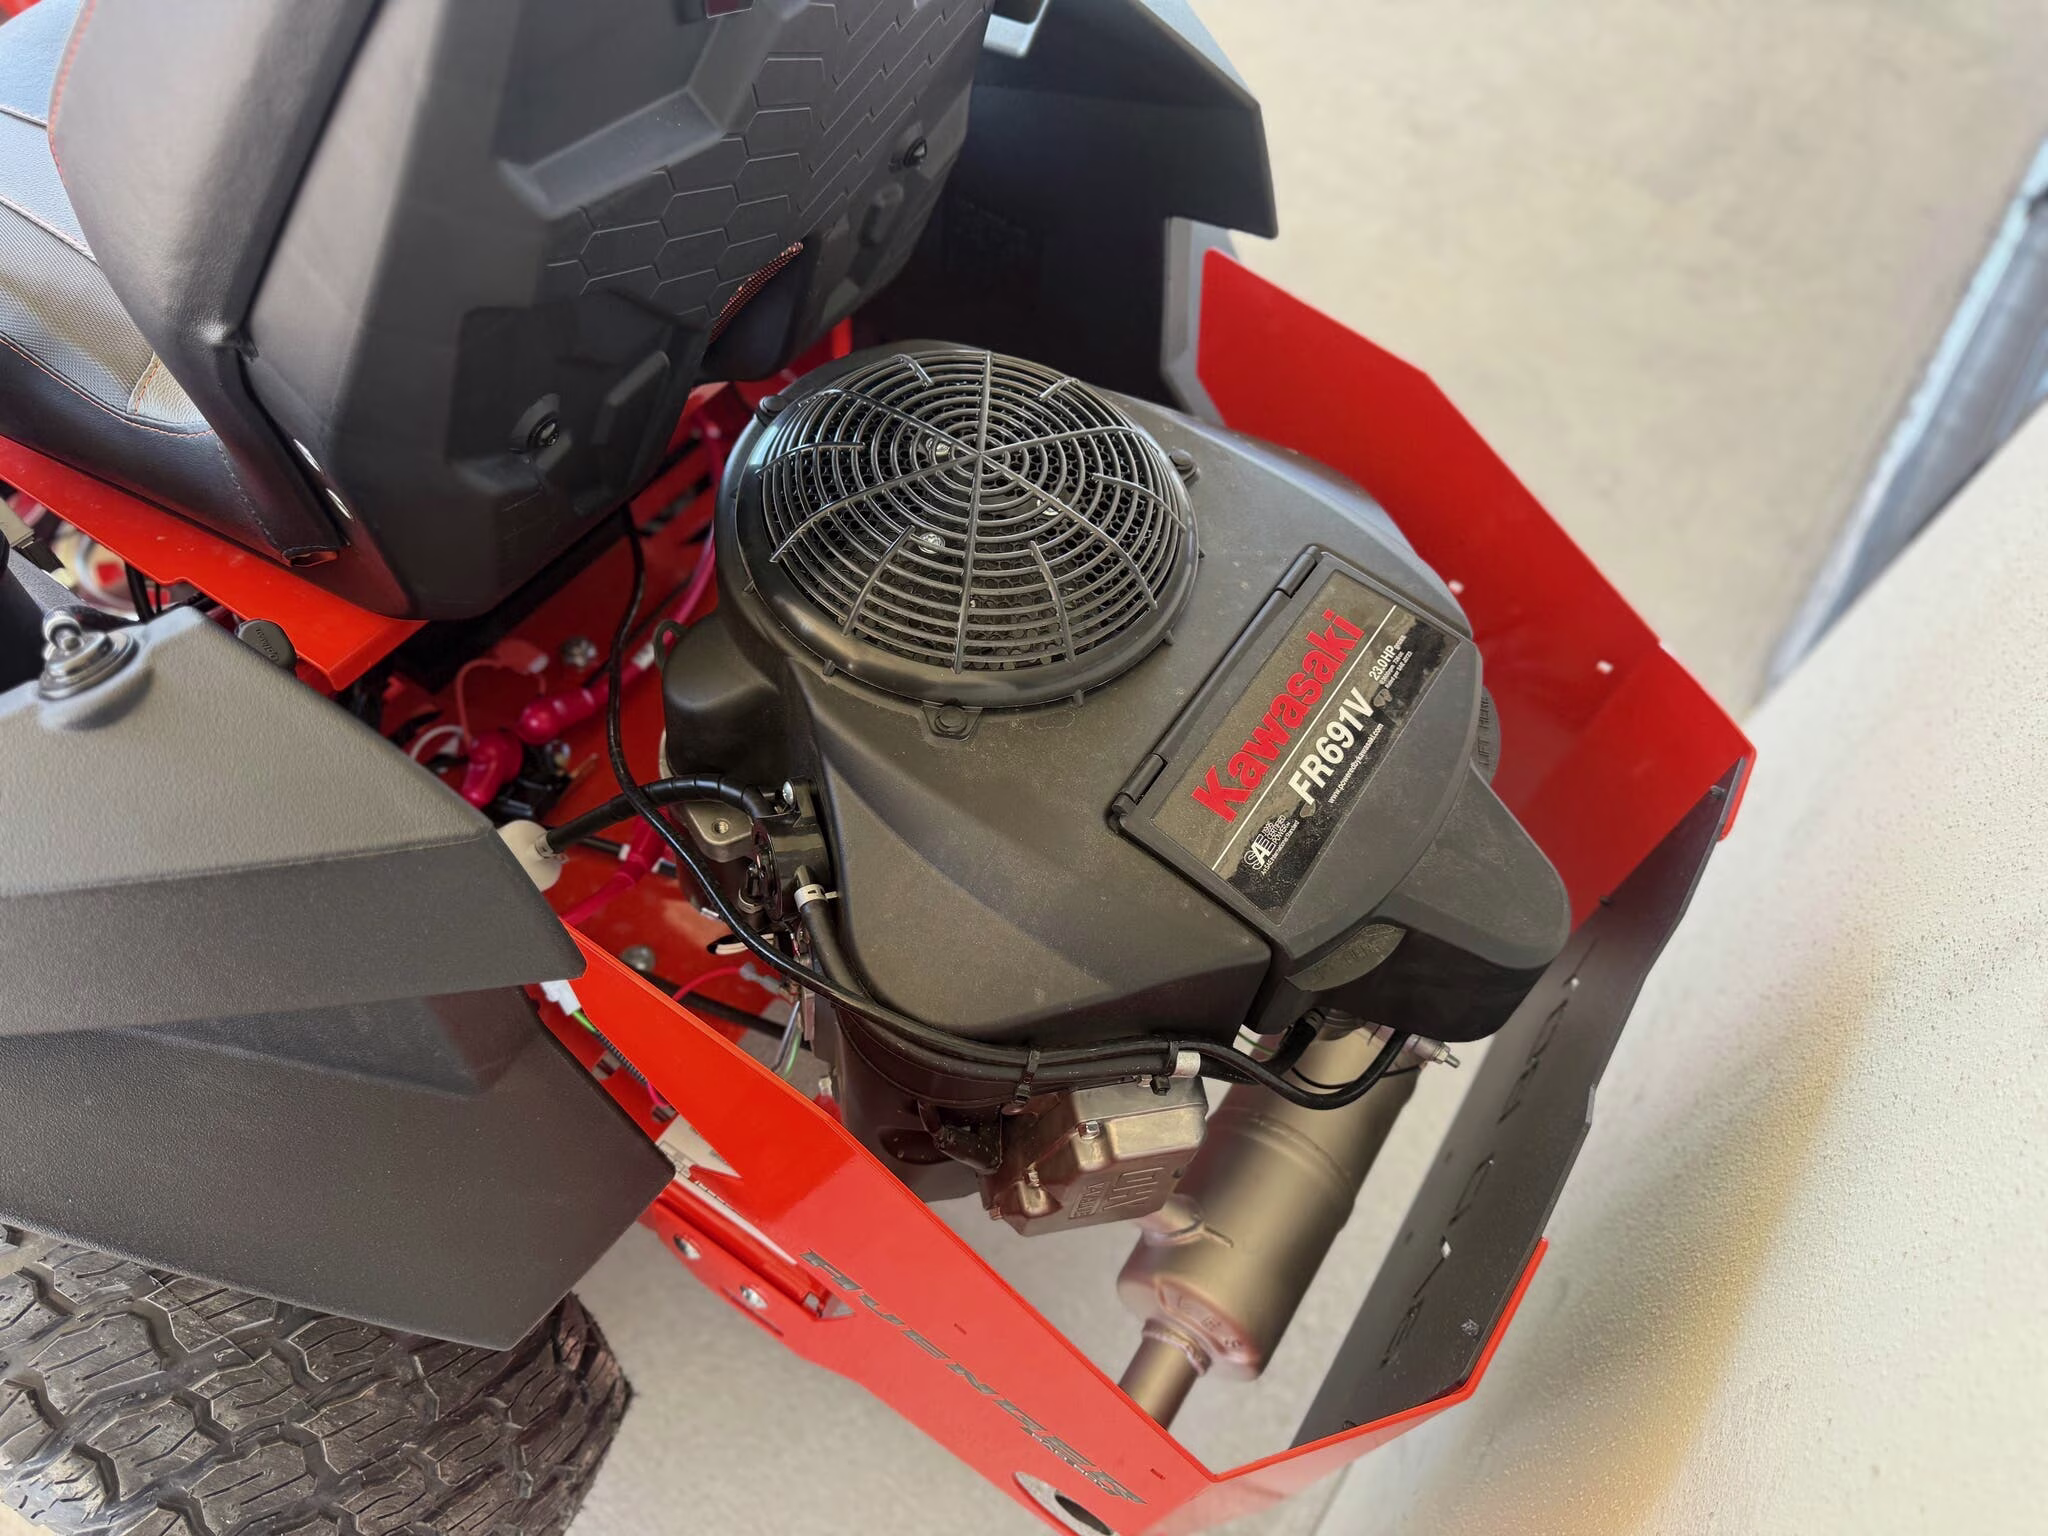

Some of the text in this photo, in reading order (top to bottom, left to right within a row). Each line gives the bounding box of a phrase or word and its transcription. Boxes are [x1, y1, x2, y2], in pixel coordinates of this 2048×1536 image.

[1192, 608, 1364, 822] Kawasaki
[1288, 687, 1374, 806] FR691V
[1327, 721, 1384, 804] www.poweredbykawasaki.com
[1478, 739, 1489, 765] LIFT
[1243, 833, 1276, 870] SAE
[1263, 858, 1273, 869] SAE
[1269, 836, 1288, 861] International
[1284, 819, 1299, 838] Standard
[1266, 814, 1286, 840] CERTIFIED
